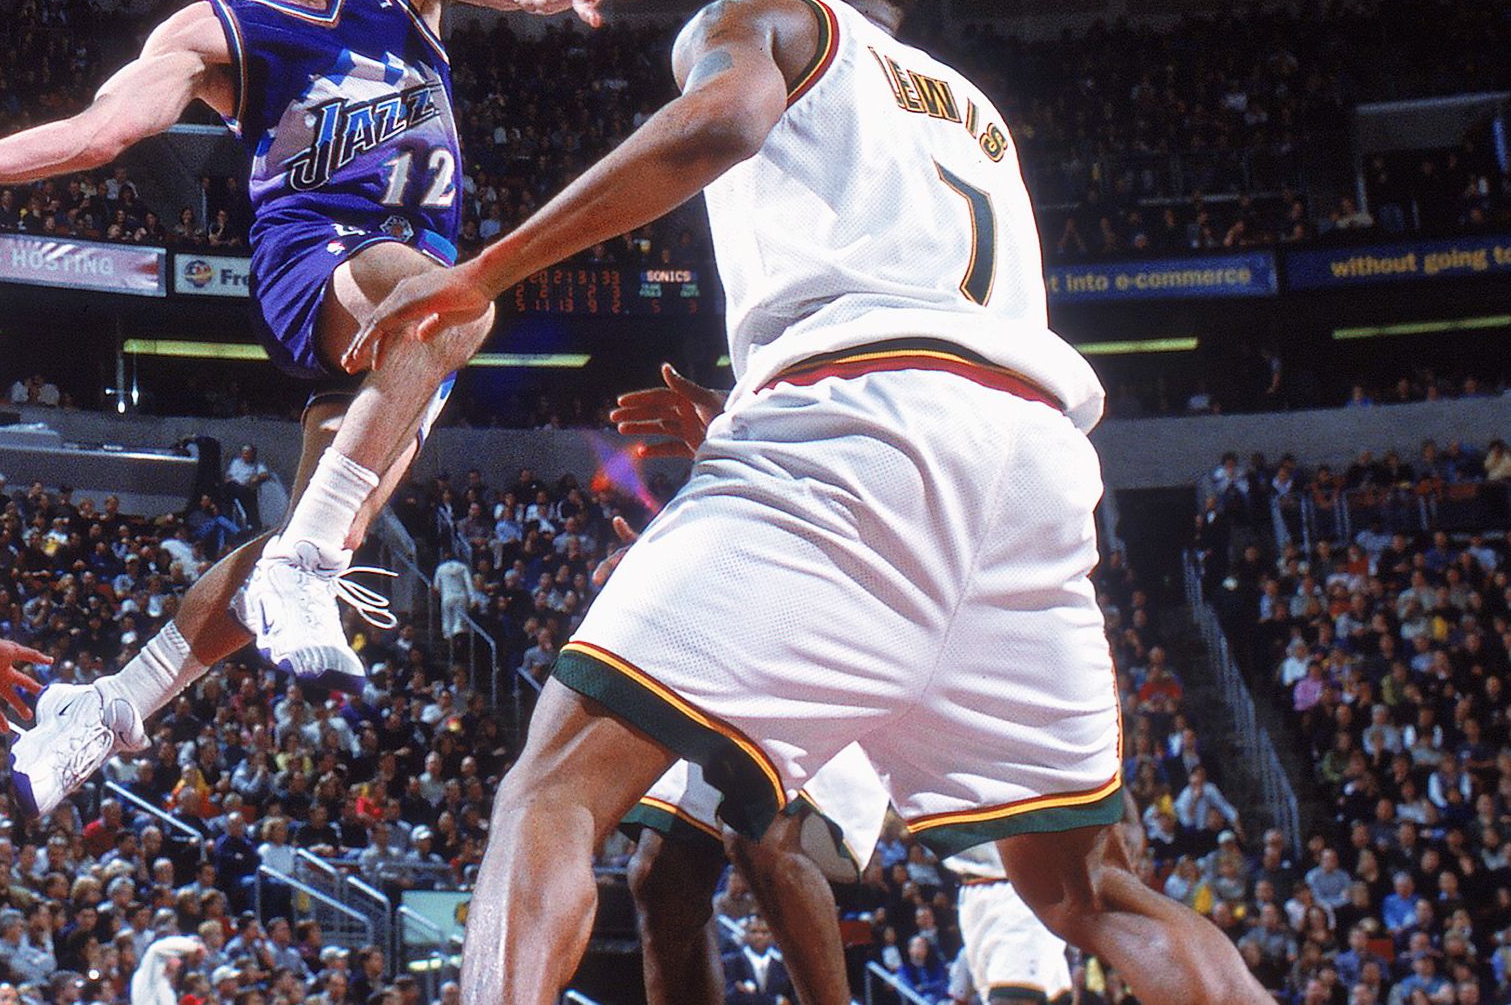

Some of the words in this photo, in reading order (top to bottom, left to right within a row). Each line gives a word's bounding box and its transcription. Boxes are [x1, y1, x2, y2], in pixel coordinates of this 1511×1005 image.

[379, 149, 457, 207] 12
[931, 154, 997, 307] 7
[10, 248, 114, 275] HOSTING
[1330, 251, 1417, 278] without
[1423, 248, 1489, 275] going
[647, 270, 691, 283] SONICS
[1065, 273, 1108, 292] into
[1115, 267, 1251, 289] e-commerce
